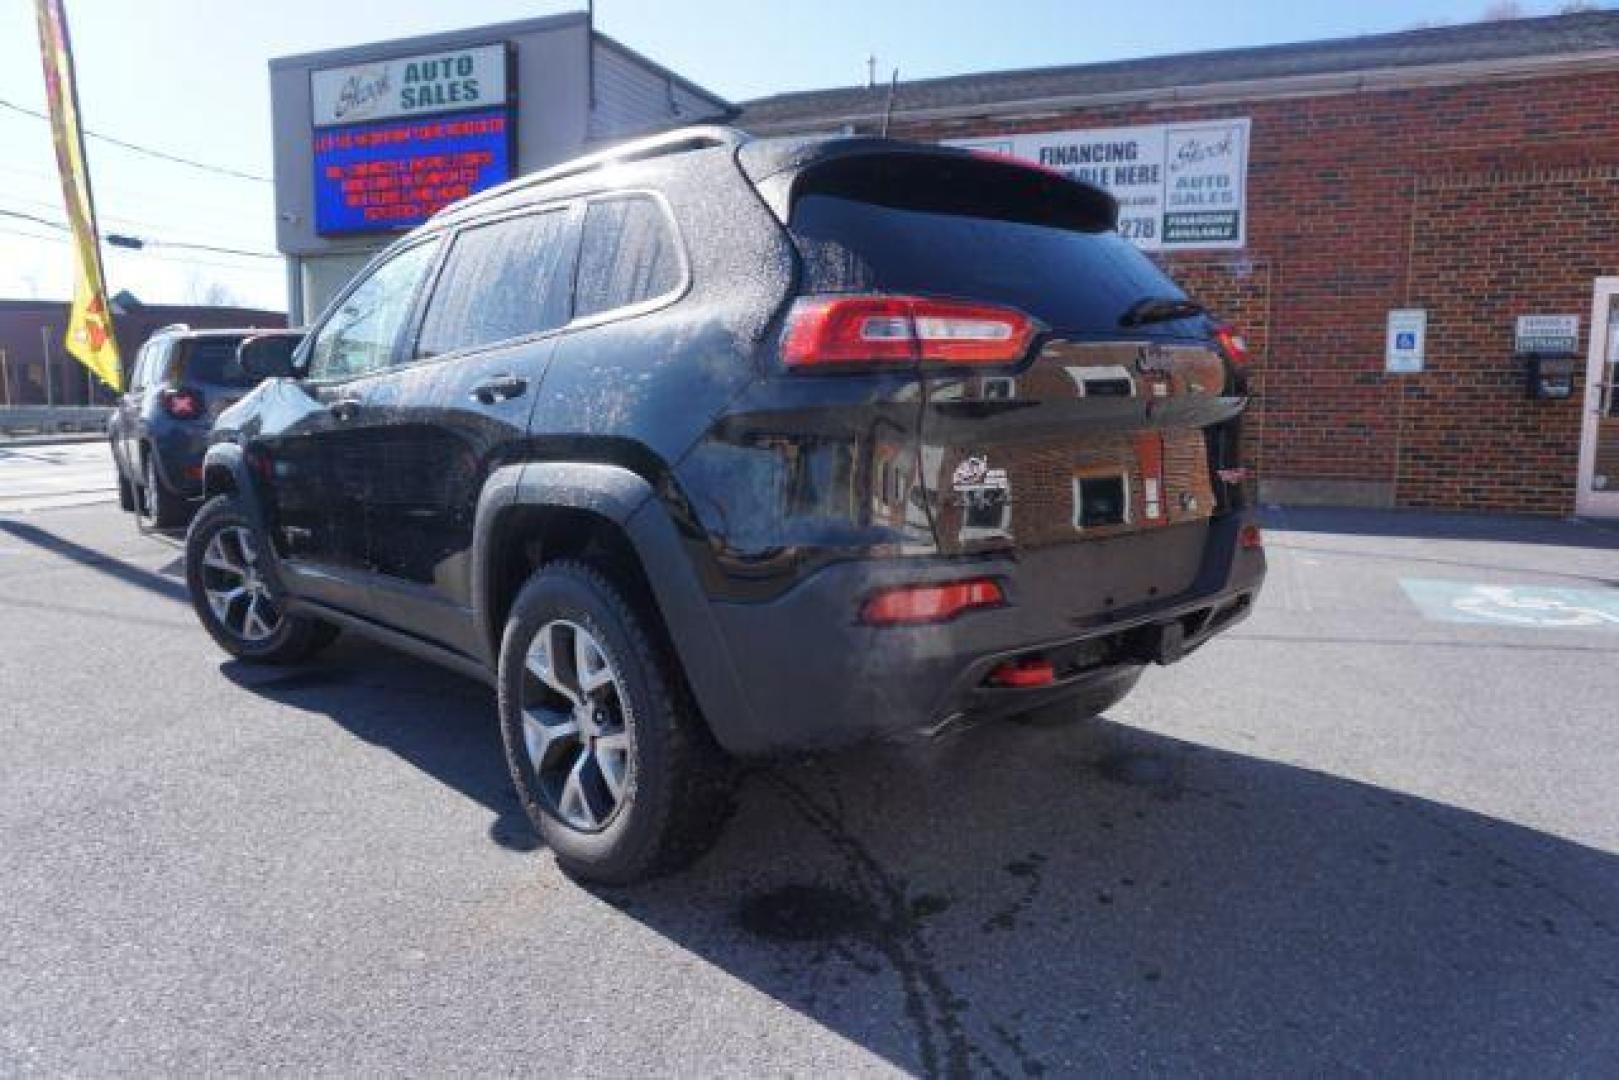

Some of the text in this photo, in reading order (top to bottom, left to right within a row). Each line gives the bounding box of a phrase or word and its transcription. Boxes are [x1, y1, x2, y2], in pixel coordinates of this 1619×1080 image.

[404, 55, 474, 84] AUTO
[401, 80, 479, 109] SALES
[1040, 141, 1138, 166] FINANCING
[1115, 164, 1160, 186] HERE
[1175, 174, 1230, 190] AUTO
